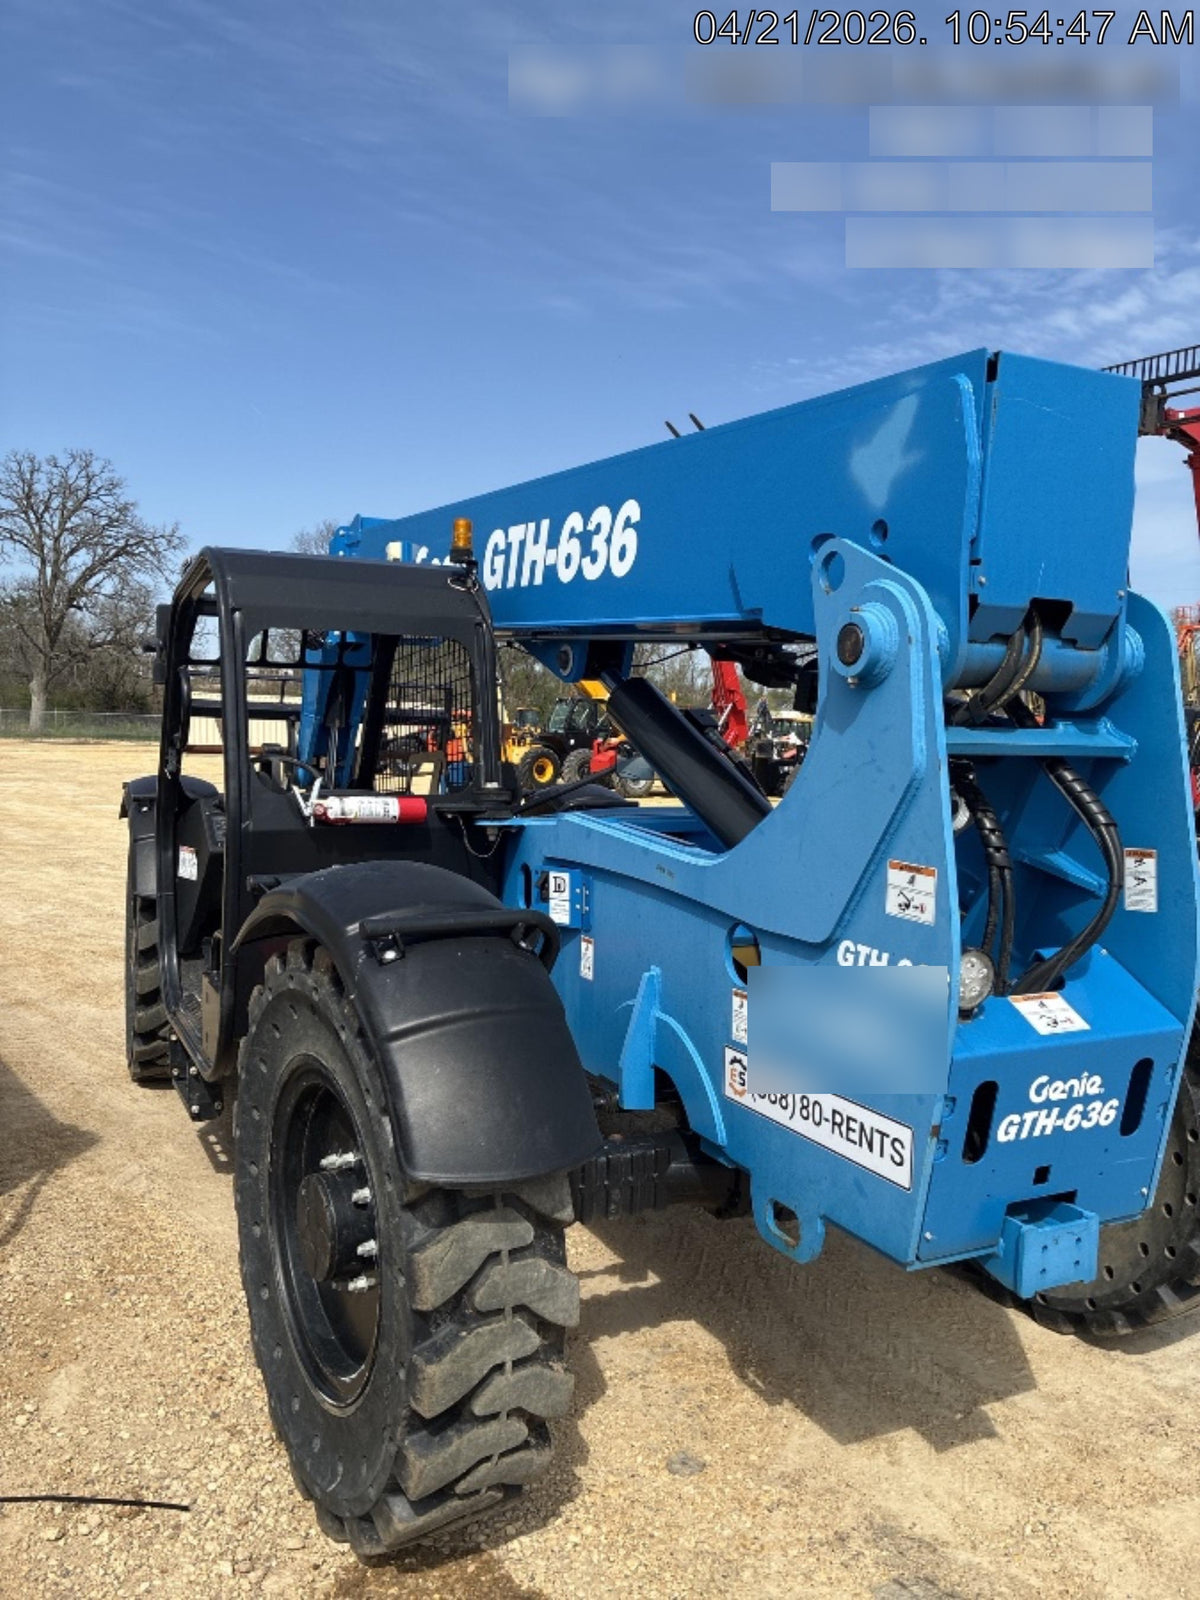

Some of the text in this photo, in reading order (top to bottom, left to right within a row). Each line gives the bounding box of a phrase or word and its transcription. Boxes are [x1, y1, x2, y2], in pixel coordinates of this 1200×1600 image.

[483, 499, 641, 591] GTH-636
[1029, 1070, 1103, 1104] Genie
[996, 1097, 1120, 1143] GTH-636
